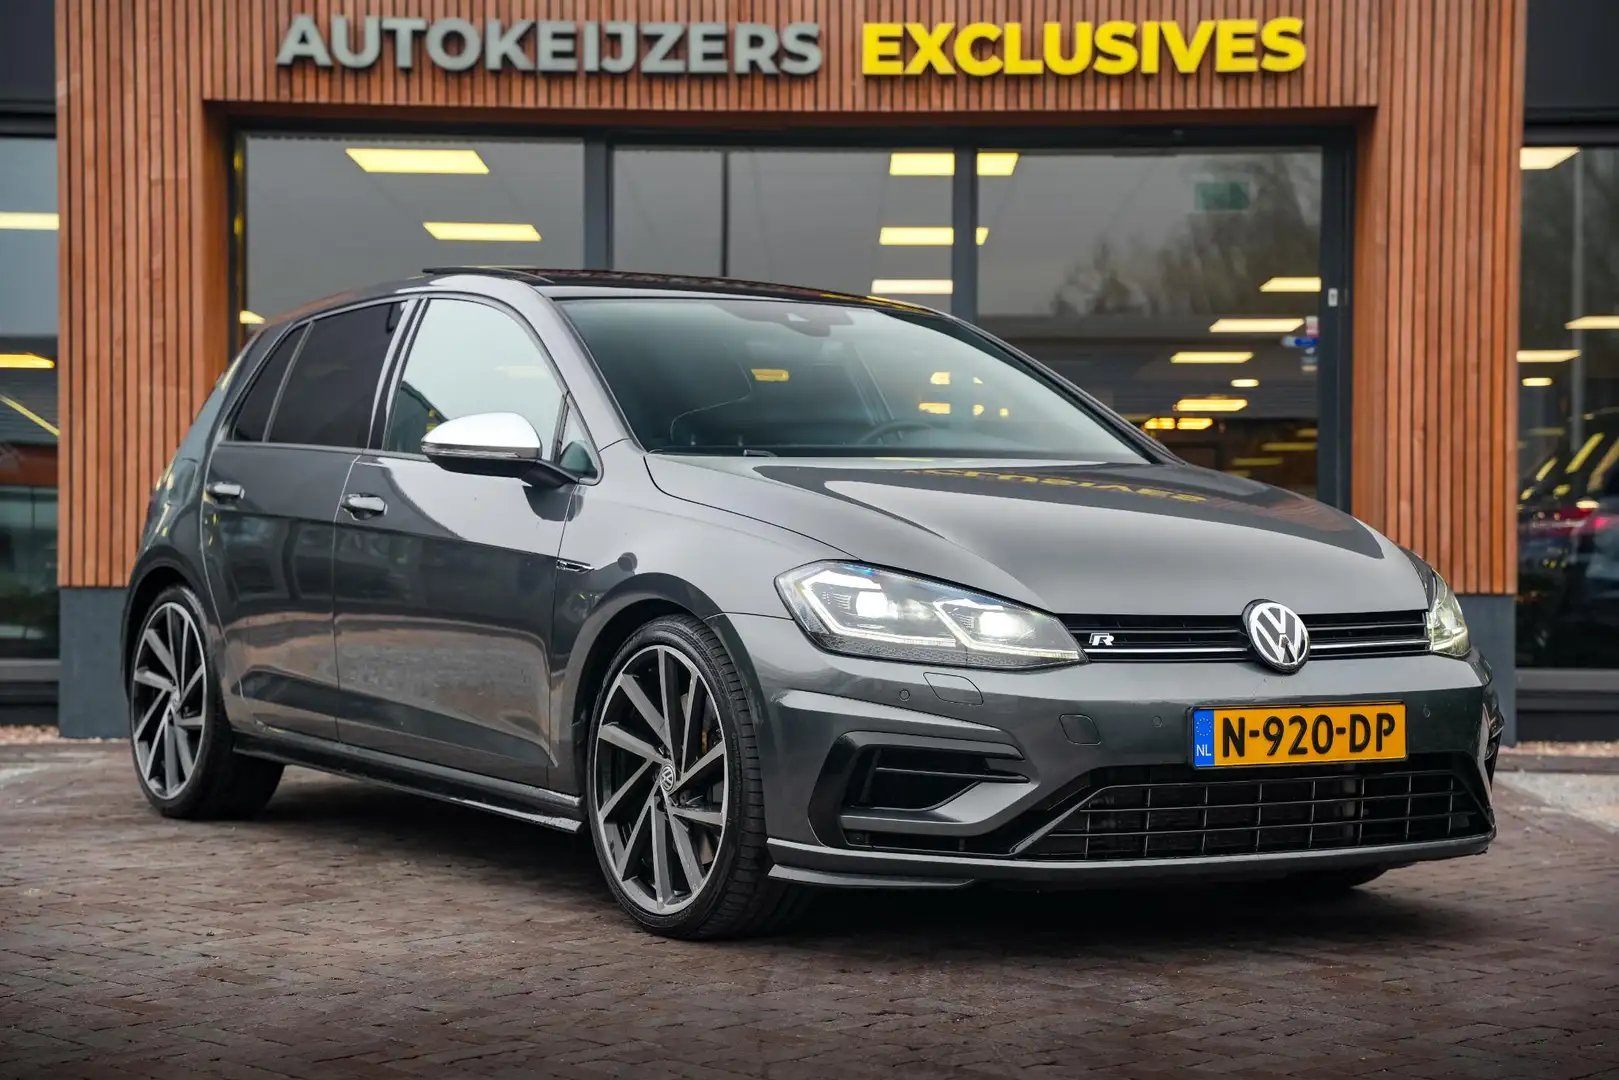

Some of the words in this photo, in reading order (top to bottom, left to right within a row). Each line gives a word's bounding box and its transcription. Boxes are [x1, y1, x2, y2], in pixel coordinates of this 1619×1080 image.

[276, 14, 823, 75] AUTOKEIJZERS
[862, 17, 1307, 76] EXCLUSIVES
[1089, 632, 1115, 646] R
[1222, 712, 1396, 758] N-920-DP
[1196, 744, 1212, 757] NL
